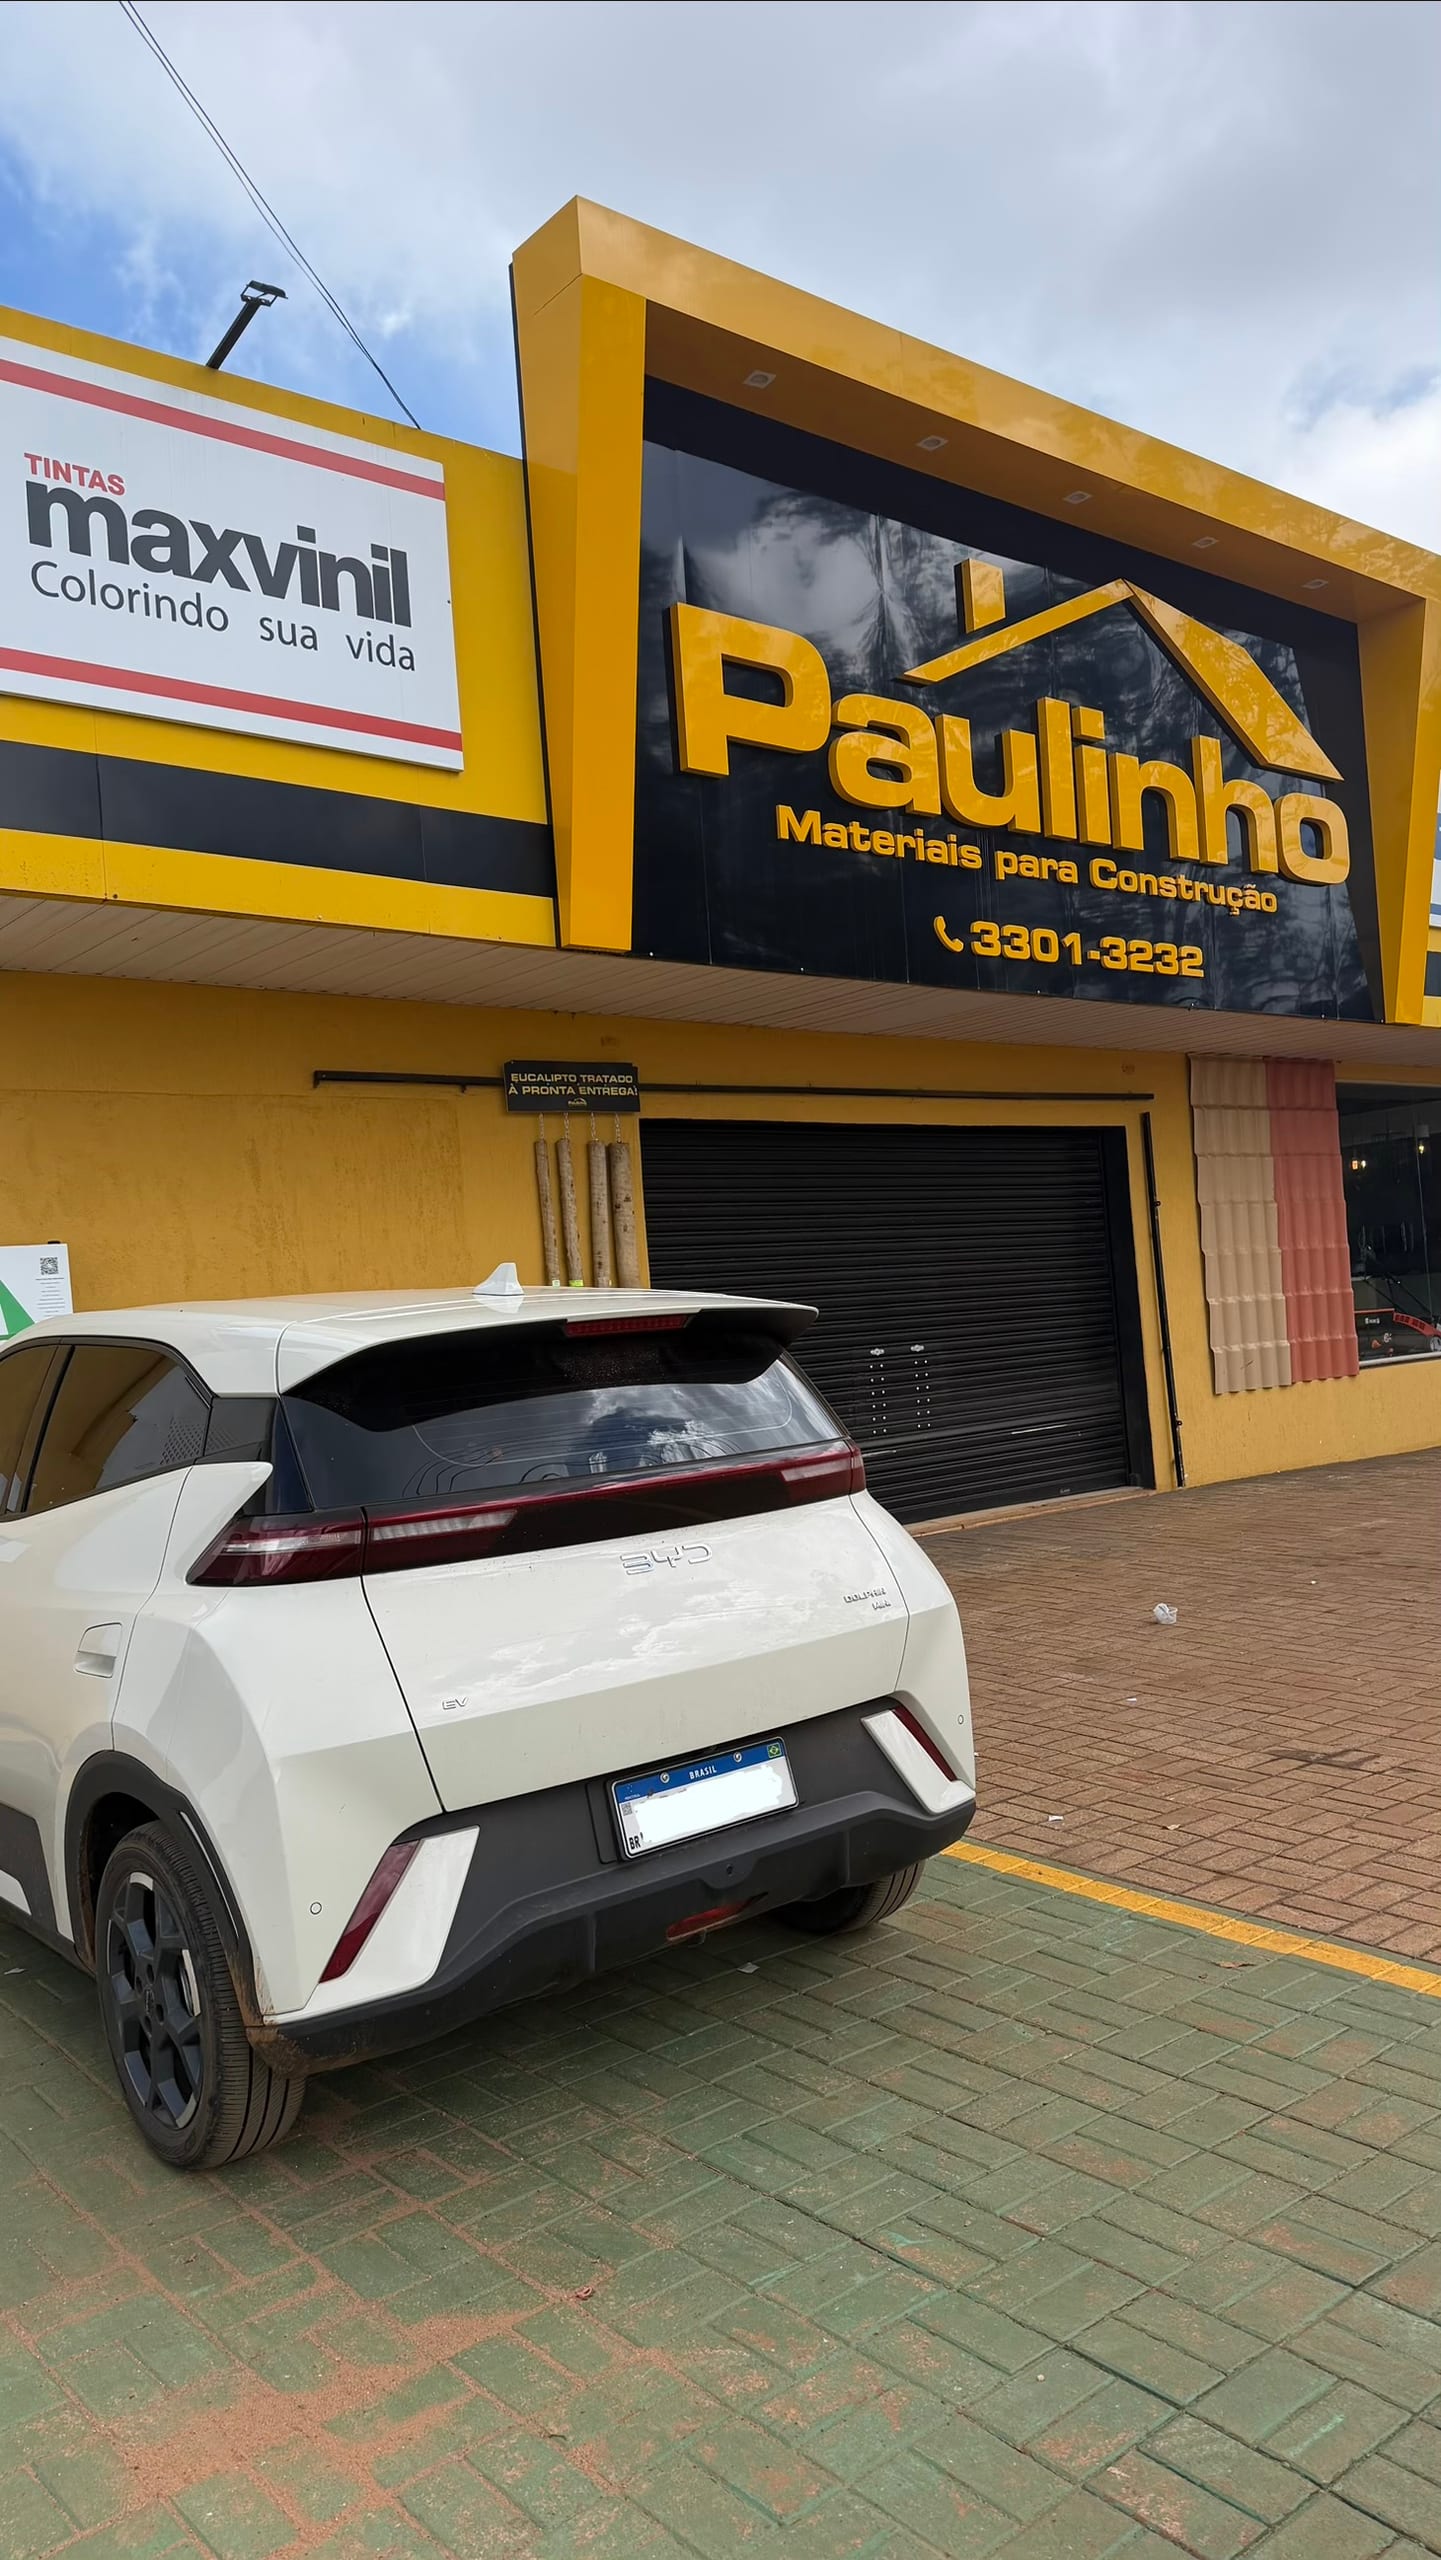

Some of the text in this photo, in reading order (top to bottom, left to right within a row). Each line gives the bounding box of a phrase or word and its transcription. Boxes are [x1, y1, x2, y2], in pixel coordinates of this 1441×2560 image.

[24, 452, 126, 496] TINTAS
[25, 480, 412, 628] maxvinil
[30, 561, 416, 672] Colorindo sua vida
[670, 601, 1351, 886] Paulinho
[776, 805, 1278, 916] Materiais para Construção
[970, 920, 1205, 978] 3301-3232
[511, 1073, 633, 1084] EUCALIPTO TRATADO
[522, 1085, 576, 1096] PRONTA
[579, 1086, 638, 1097] ENTREGA!
[620, 1544, 712, 1575] BYD
[442, 1696, 468, 1711] EV
[688, 1765, 718, 1780] BRASIL
[628, 1835, 642, 1851] BR
